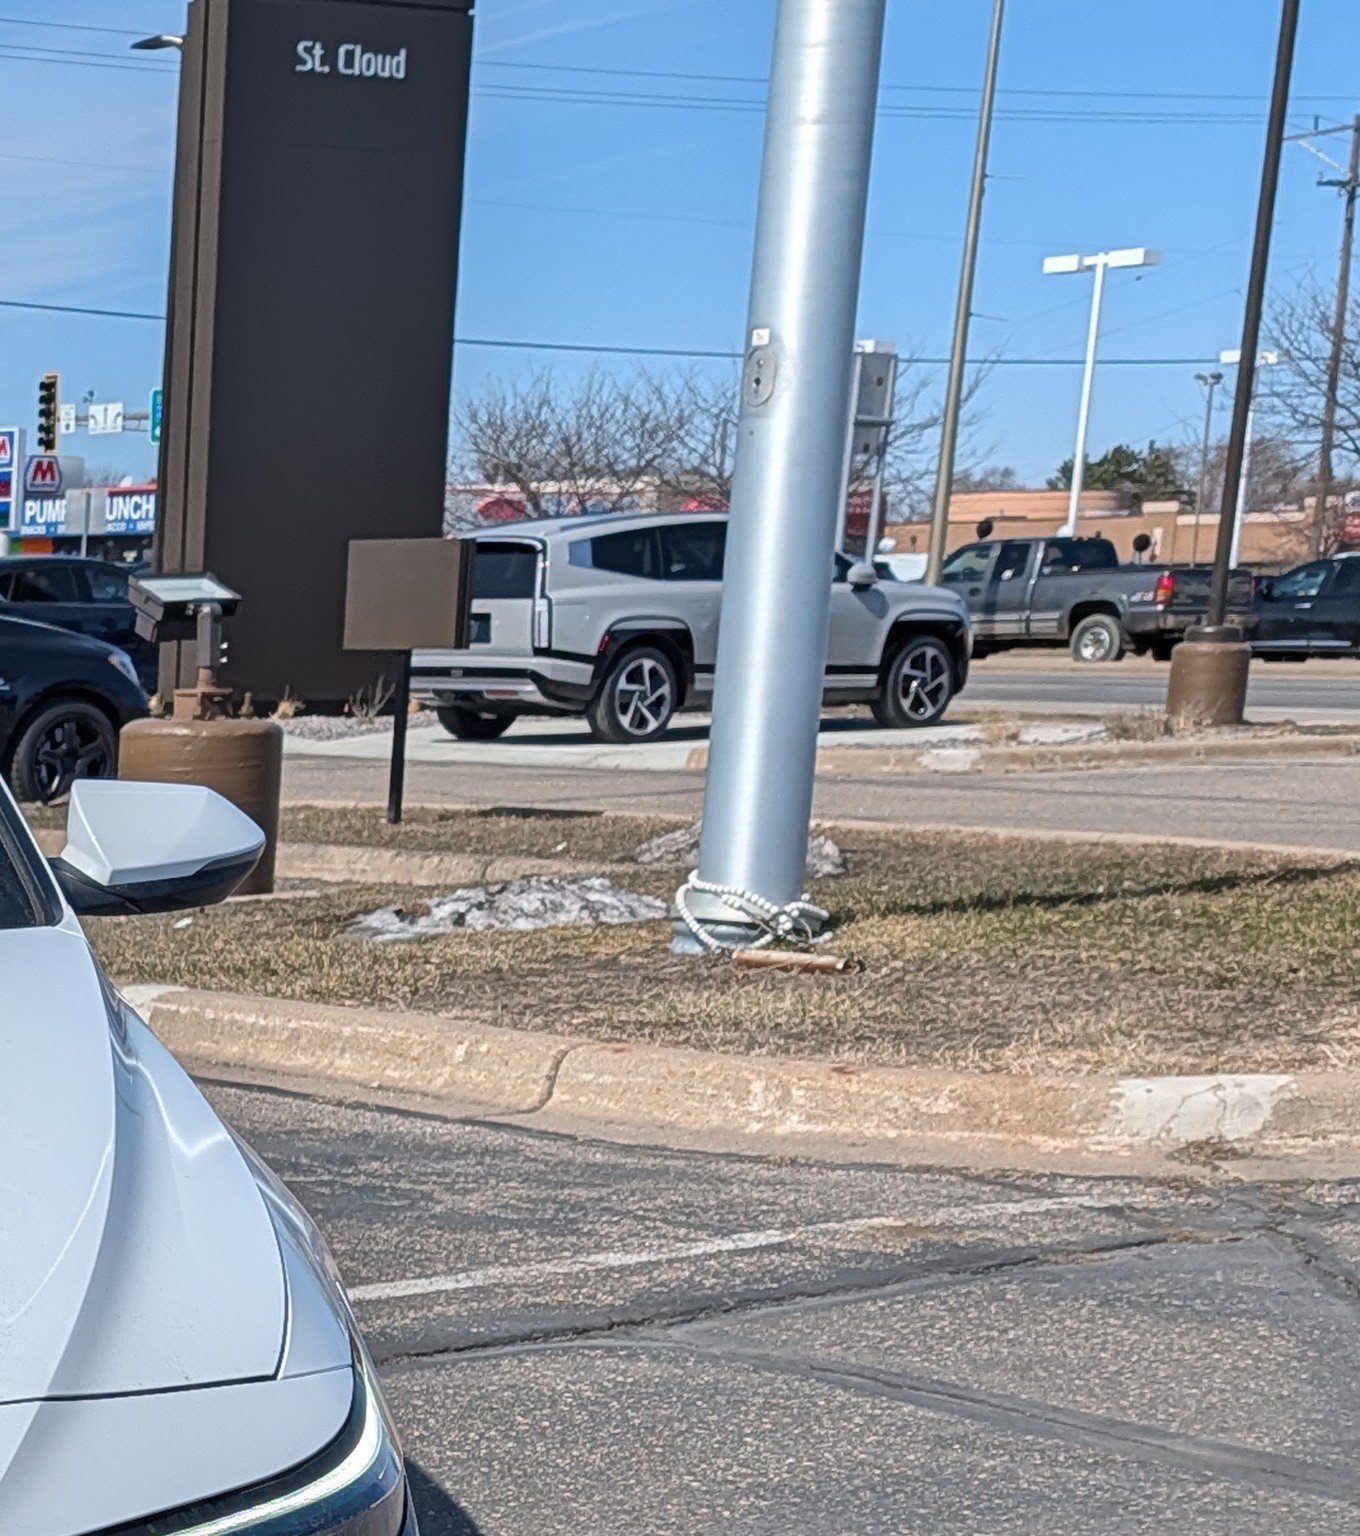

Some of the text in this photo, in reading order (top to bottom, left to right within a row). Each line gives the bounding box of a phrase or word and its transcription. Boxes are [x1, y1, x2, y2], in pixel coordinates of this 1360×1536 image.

[294, 40, 407, 79] St. Cloud
[105, 493, 155, 520] UNCH
